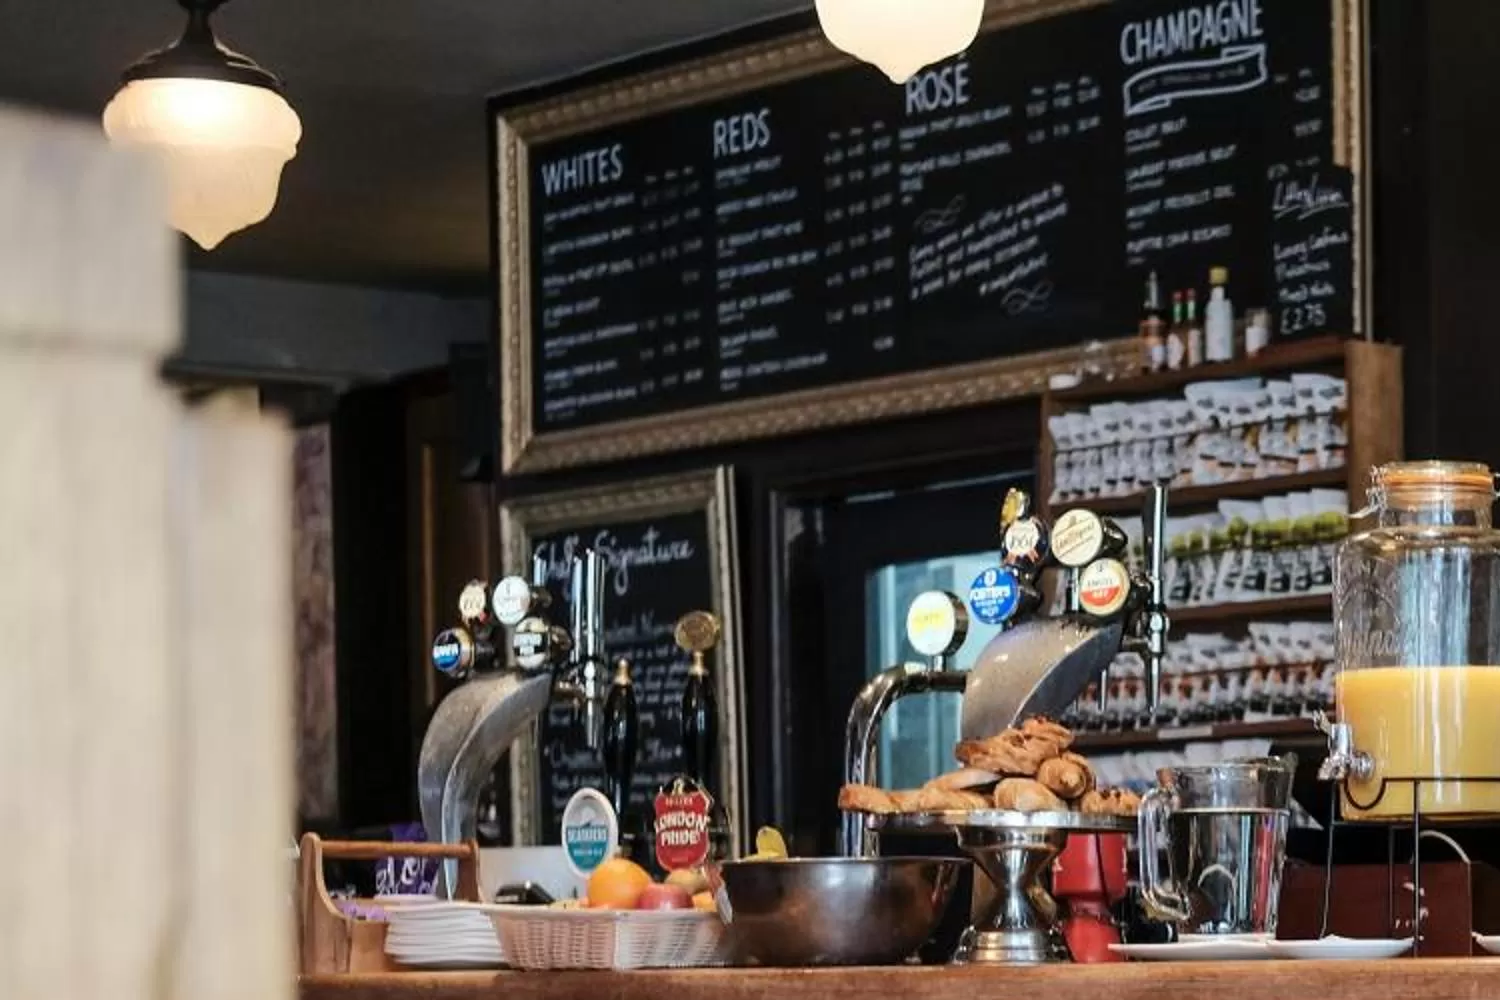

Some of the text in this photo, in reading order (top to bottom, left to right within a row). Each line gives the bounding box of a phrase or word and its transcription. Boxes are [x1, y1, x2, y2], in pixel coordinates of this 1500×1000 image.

[1120, 0, 1264, 65] CHAMPAGNE
[713, 107, 771, 160] REDS
[541, 143, 624, 197] WHITES
[594, 525, 695, 597] Signature
[654, 809, 711, 834] LONDON
[661, 828, 701, 847] PRIDE
